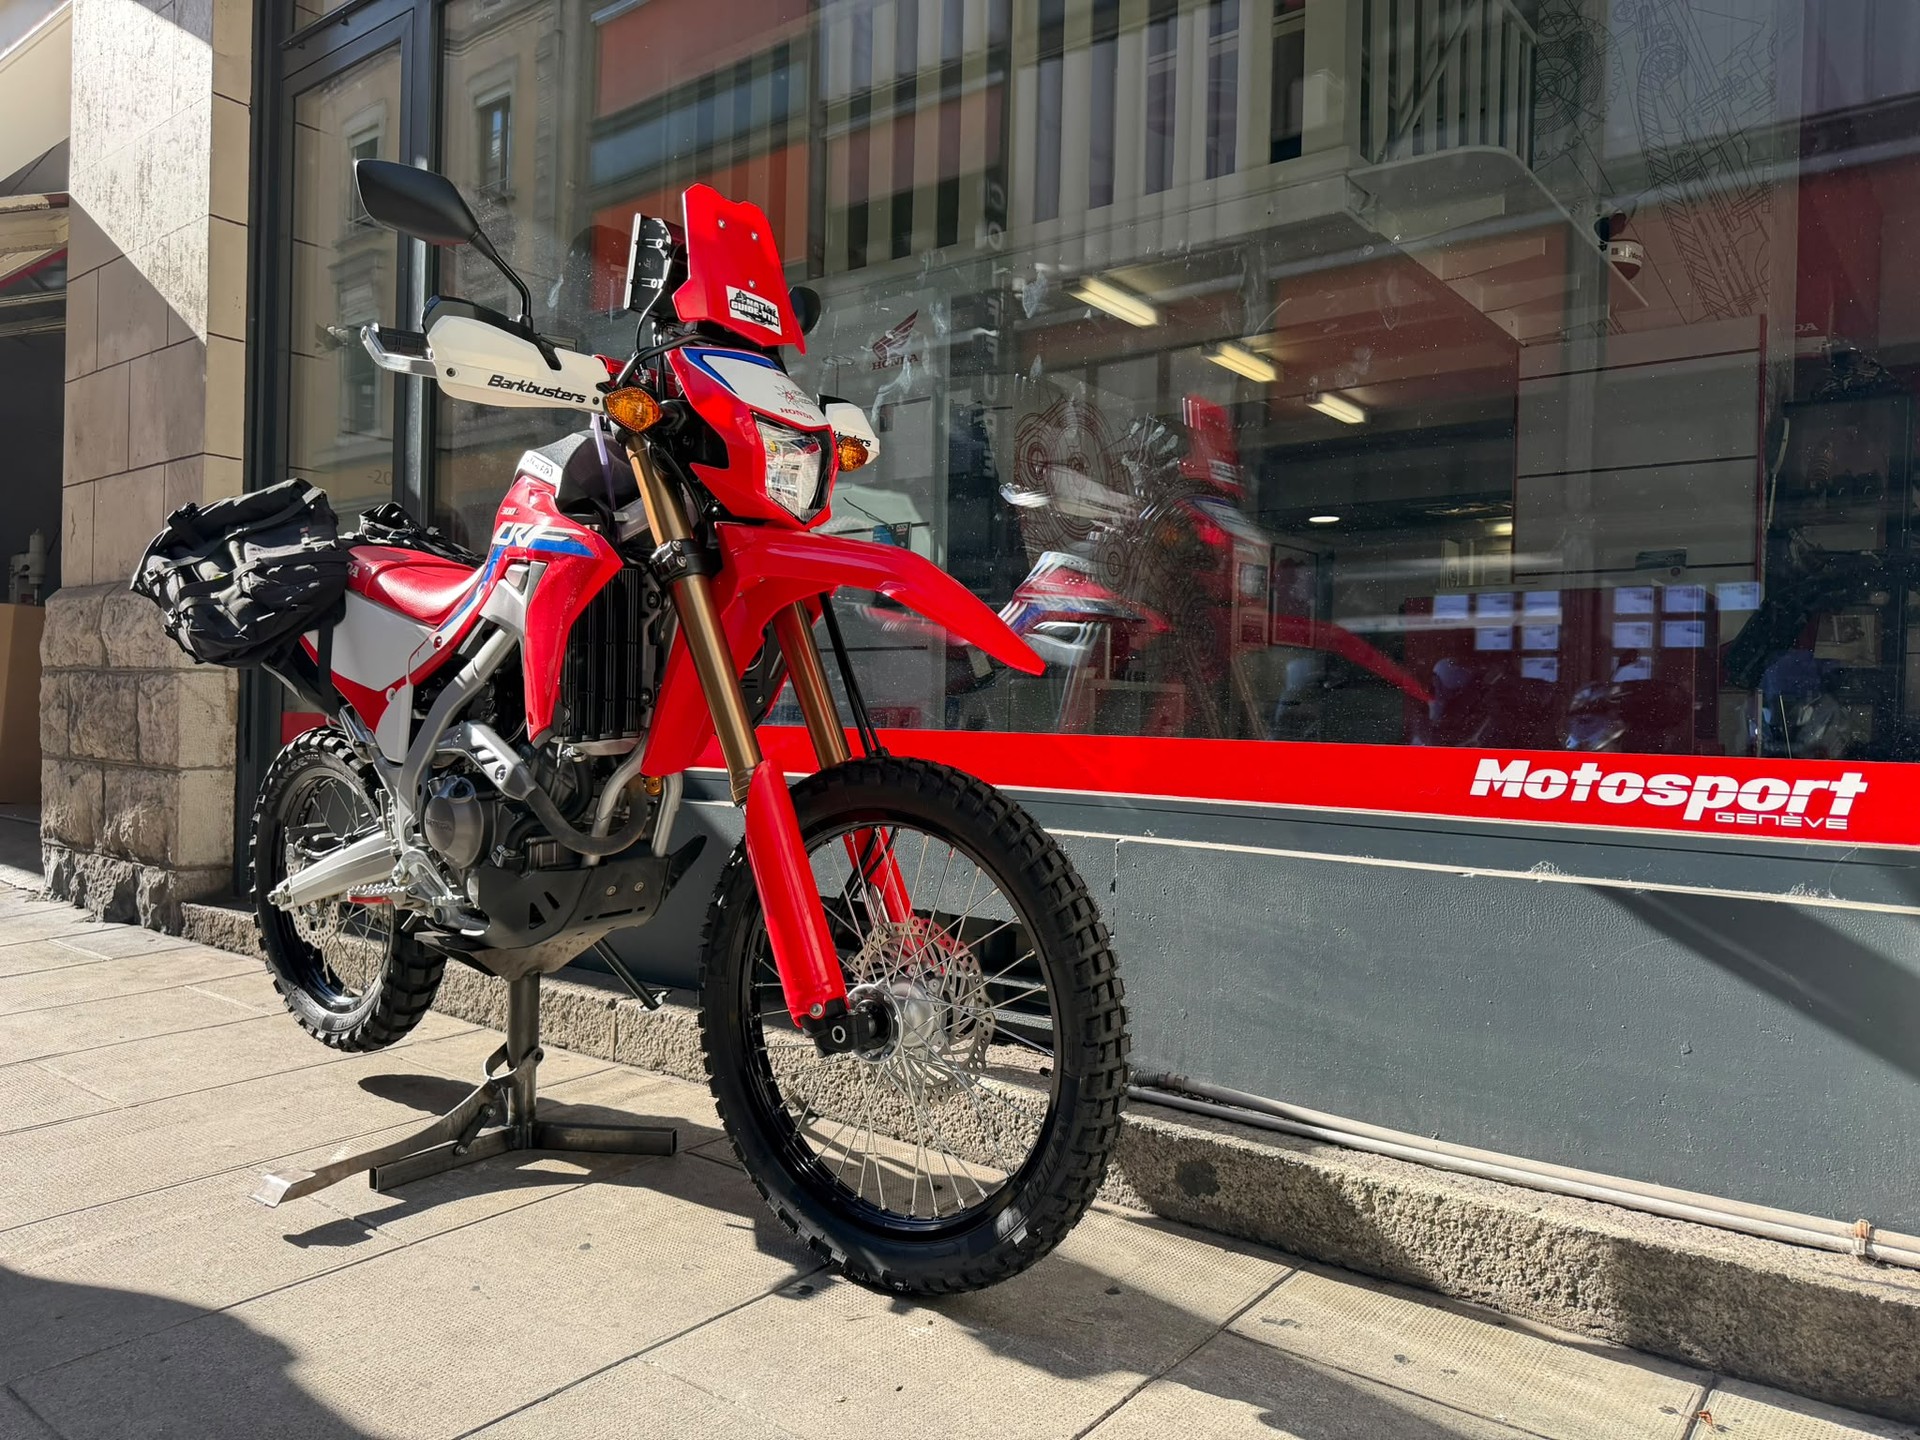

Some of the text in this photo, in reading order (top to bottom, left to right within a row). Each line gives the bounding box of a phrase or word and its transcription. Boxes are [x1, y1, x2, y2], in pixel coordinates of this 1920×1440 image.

[487, 374, 587, 404] Barkbusters
[780, 406, 817, 422] HONDA
[491, 521, 586, 548] CRF
[1469, 758, 1868, 821] Motosport
